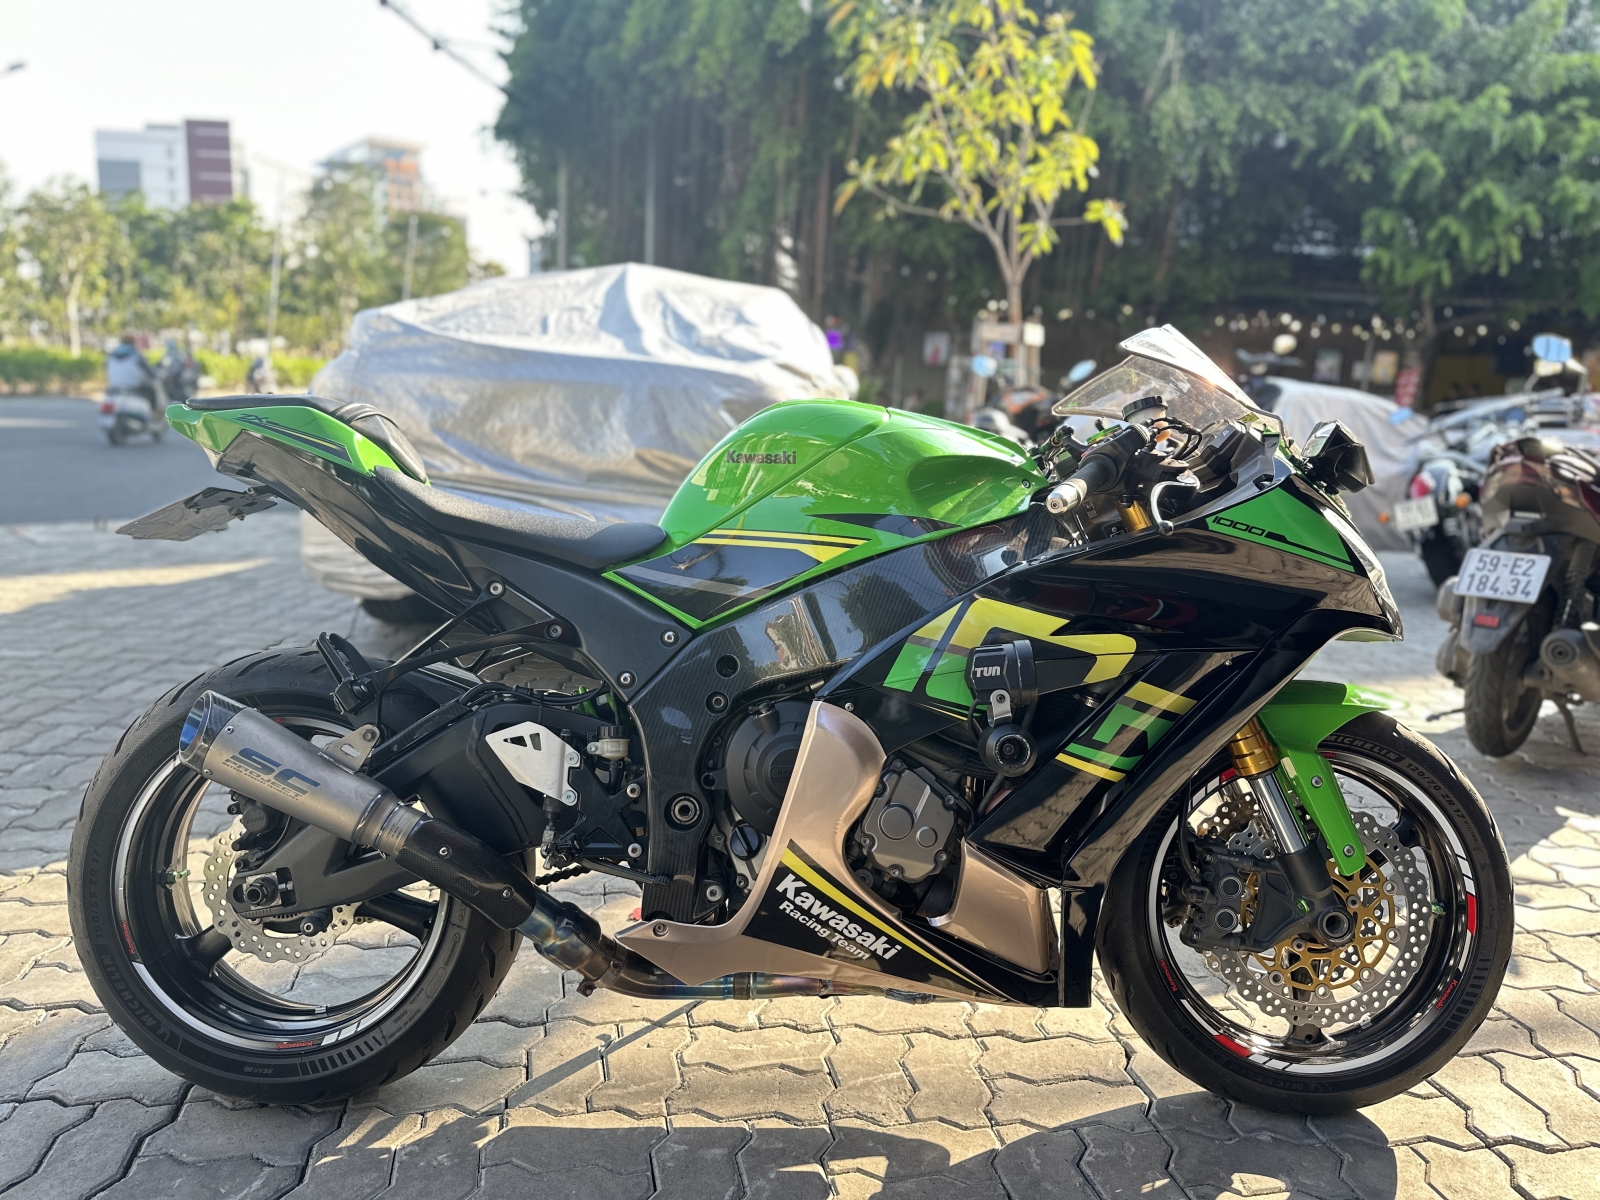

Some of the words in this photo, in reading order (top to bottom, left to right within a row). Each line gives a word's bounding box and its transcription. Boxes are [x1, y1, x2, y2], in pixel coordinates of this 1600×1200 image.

[726, 449, 797, 465] Kawasaki
[1211, 515, 1267, 537] 1000
[1475, 553, 1537, 577] 59-E2
[1465, 573, 1533, 598] 184.34
[224, 758, 304, 798] PROJECT
[229, 747, 322, 796] SC
[1325, 734, 1399, 761] MICHELIN
[1405, 763, 1442, 792] 120/70
[1440, 793, 1455, 806] ZR
[89, 867, 99, 885] ZR
[88, 890, 103, 940] 190/55
[775, 872, 903, 960] Kawasaki
[778, 900, 832, 938] Racing
[831, 932, 872, 961] Team
[100, 953, 158, 1033] MICHELIN
[1435, 979, 1459, 1010] Kawasaki
